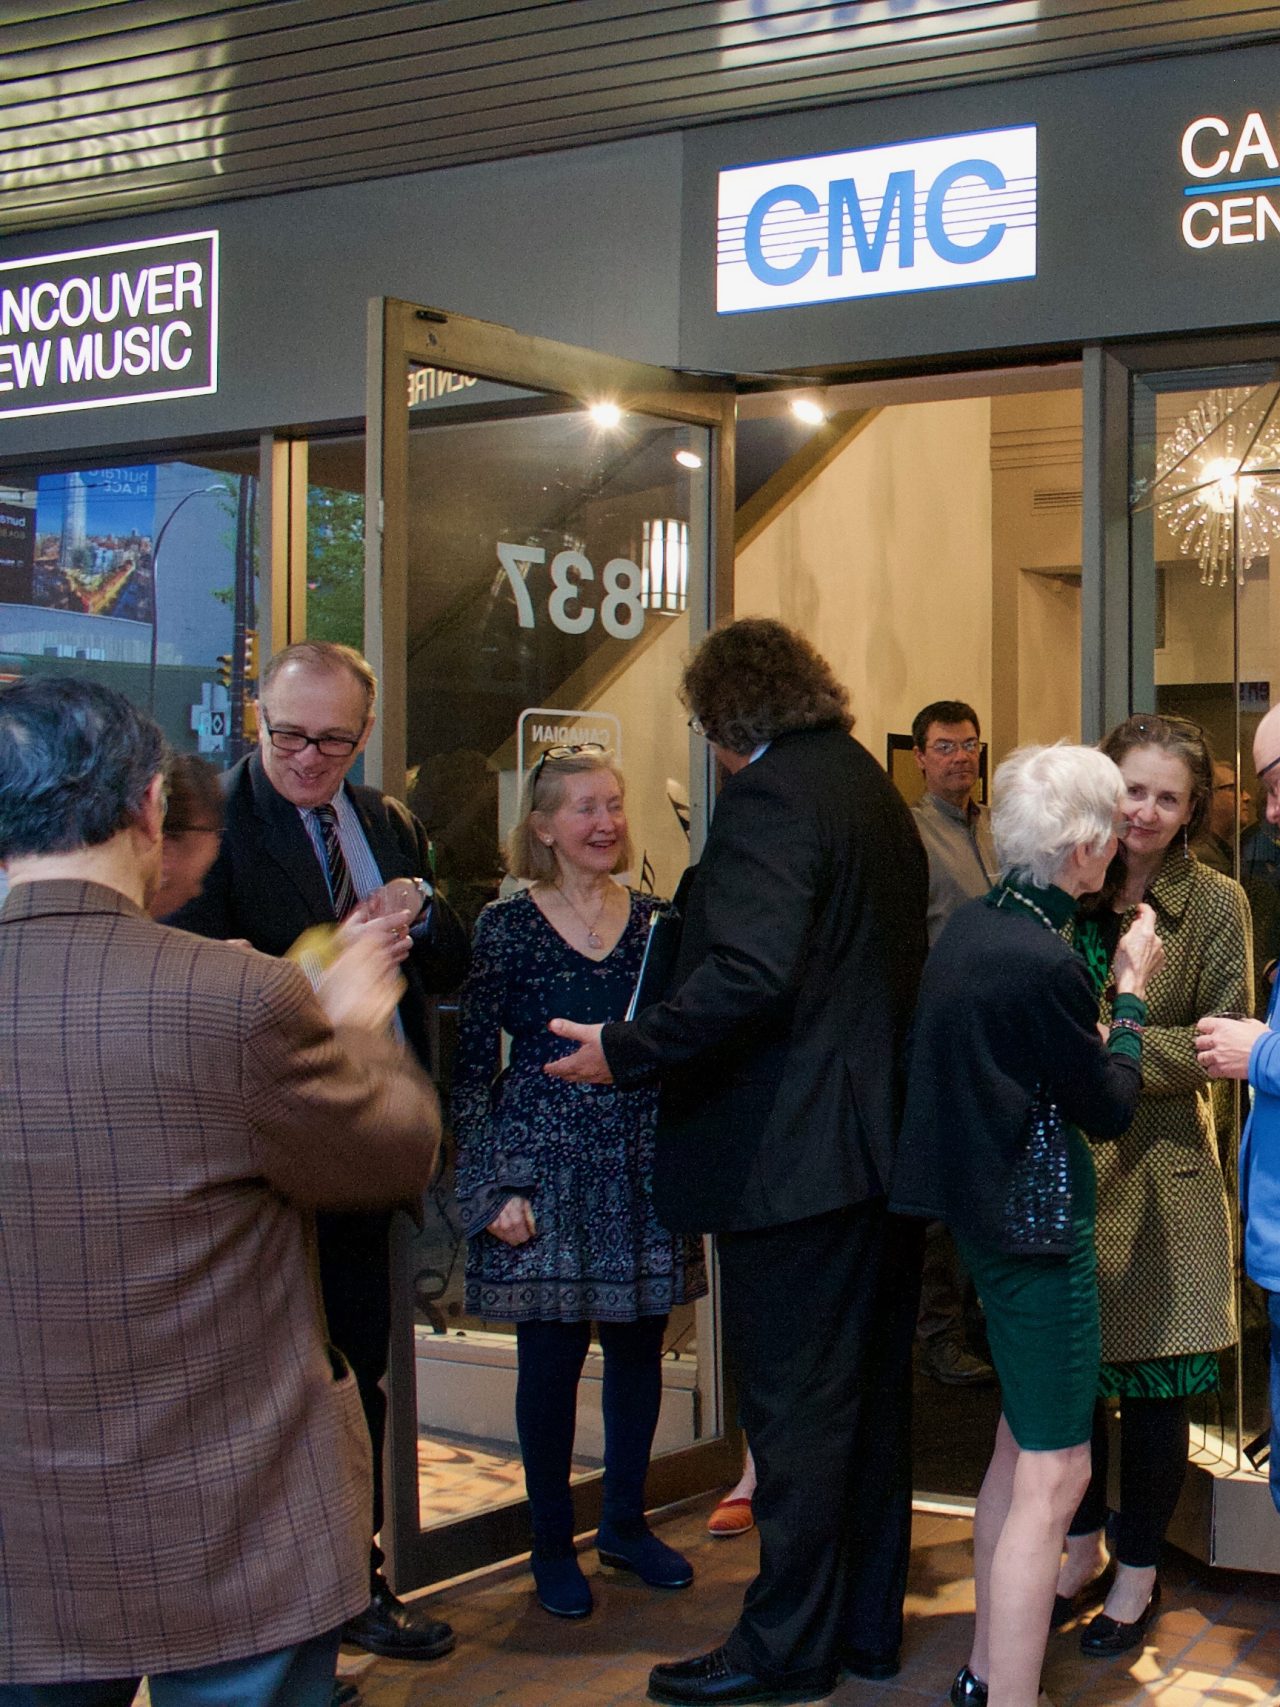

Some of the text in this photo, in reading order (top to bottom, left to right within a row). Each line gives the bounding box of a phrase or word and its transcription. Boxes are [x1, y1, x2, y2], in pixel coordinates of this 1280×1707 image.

[743, 158, 1007, 287] CMC
[0, 261, 203, 336] NCOUVER
[60, 320, 192, 384] MUSIC
